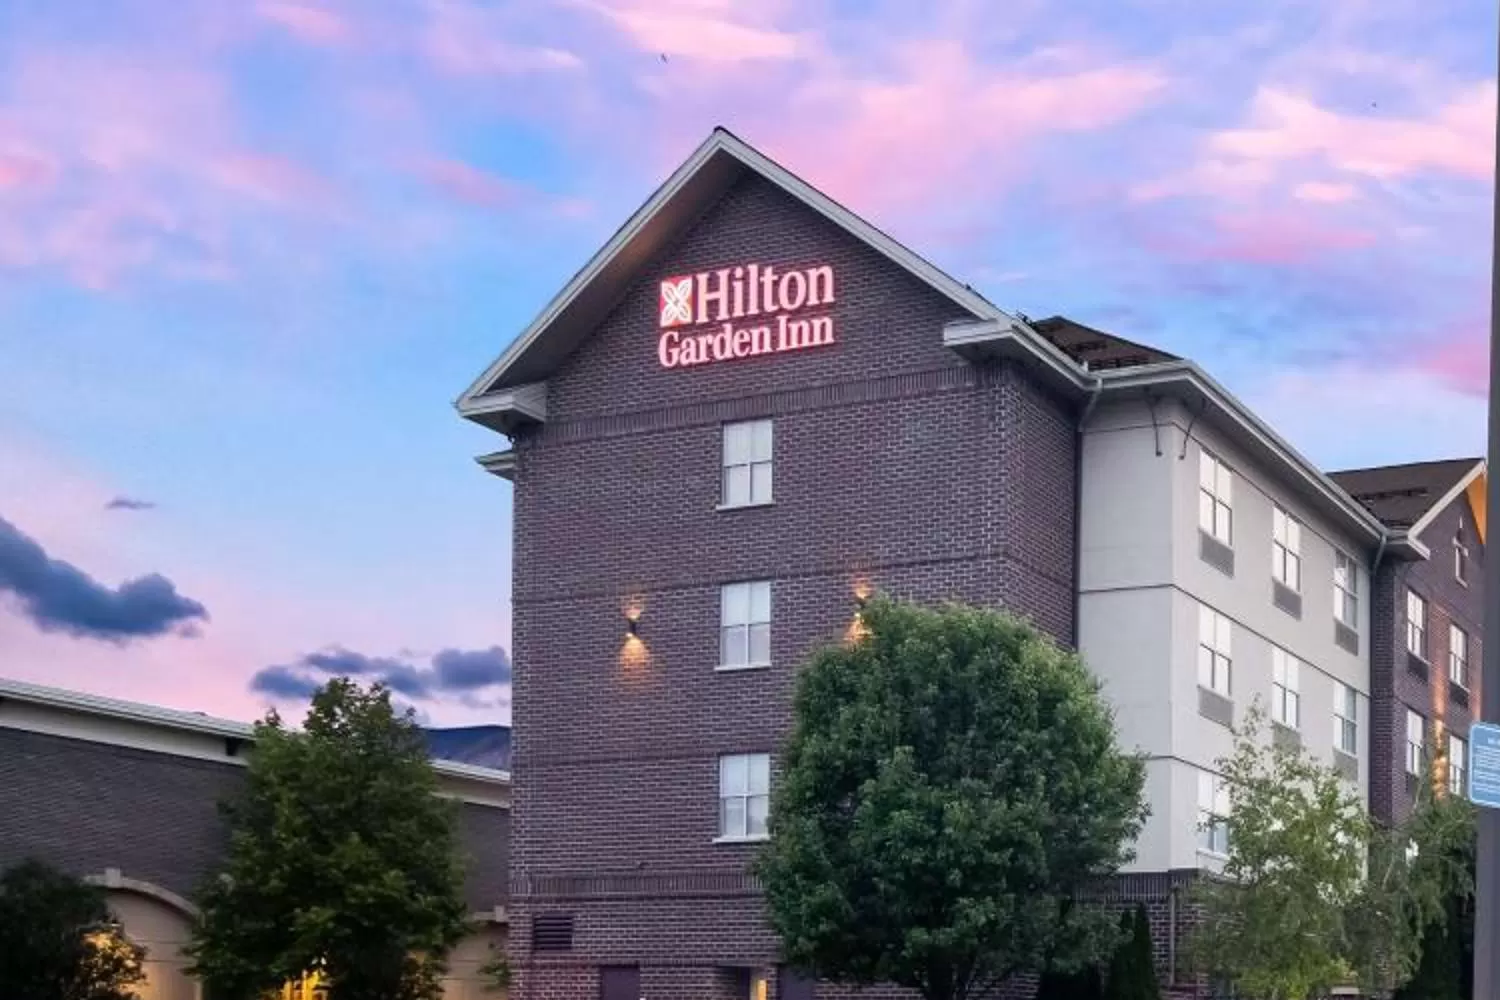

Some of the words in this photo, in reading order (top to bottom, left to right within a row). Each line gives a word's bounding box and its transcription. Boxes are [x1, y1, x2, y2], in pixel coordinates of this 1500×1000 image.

[696, 264, 834, 323] Hilton
[658, 323, 773, 368] Garden
[776, 315, 835, 351] Inn
